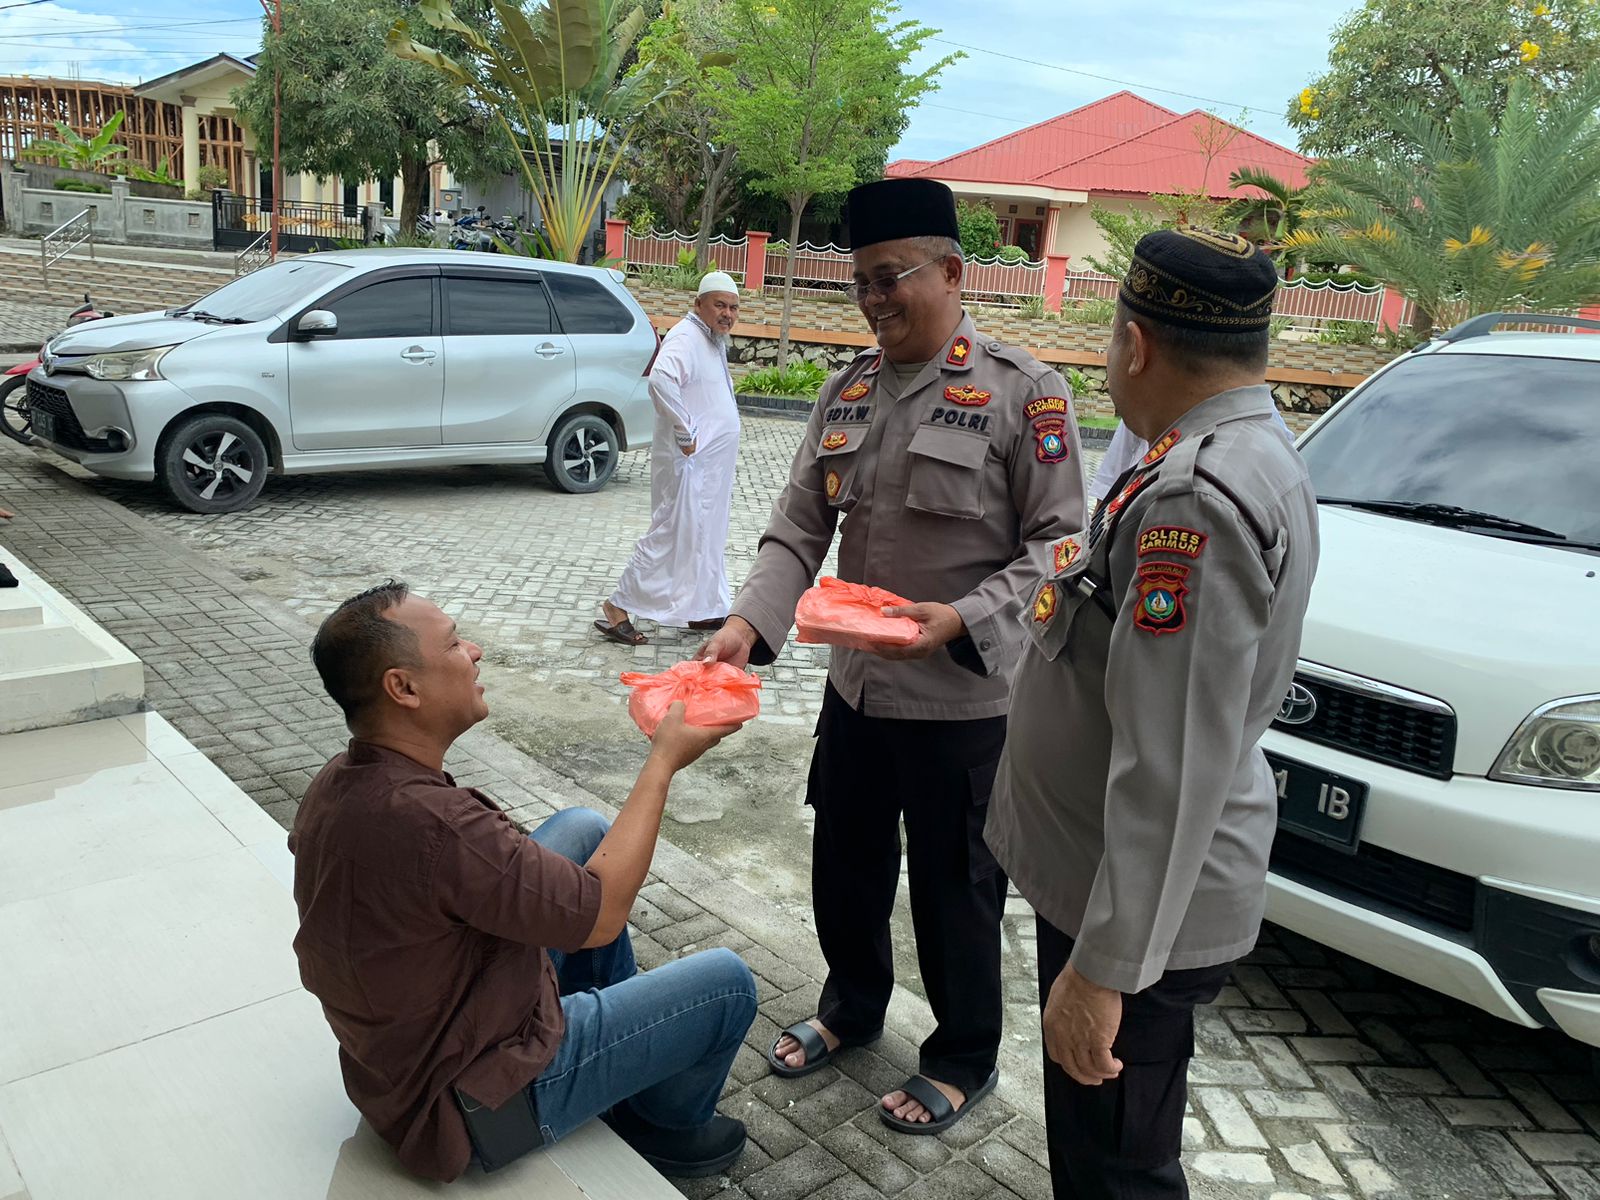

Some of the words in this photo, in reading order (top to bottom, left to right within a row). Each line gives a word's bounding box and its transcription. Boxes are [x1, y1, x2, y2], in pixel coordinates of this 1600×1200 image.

[931, 406, 989, 431] POLRI
[1140, 539, 1198, 553] KARIMUN
[1141, 529, 1200, 546] POLRES
[1317, 783, 1351, 820] IB
